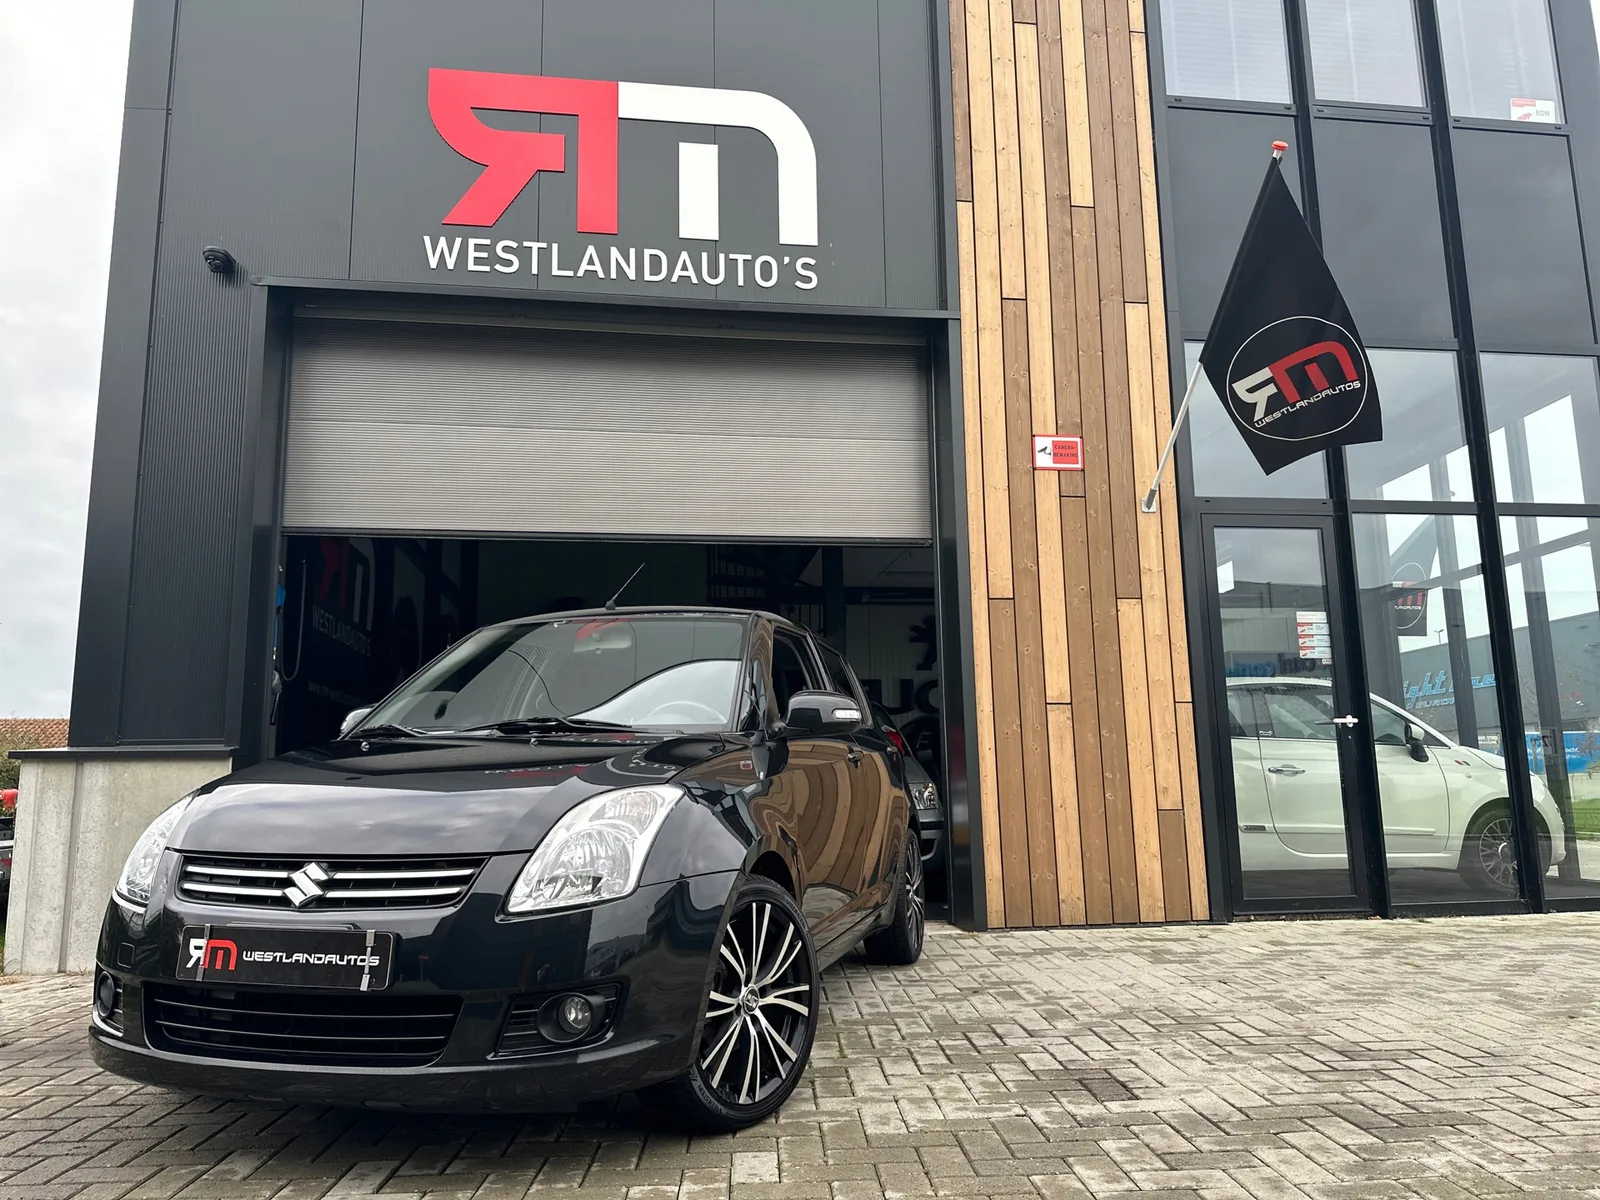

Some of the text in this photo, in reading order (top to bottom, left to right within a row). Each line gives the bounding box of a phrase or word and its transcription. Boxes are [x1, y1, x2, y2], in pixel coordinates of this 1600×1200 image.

[423, 235, 819, 290] WESTLANDAUTO'S
[1254, 380, 1361, 428] WESTLANDAUTOS
[1403, 670, 1447, 709] ight
[243, 950, 380, 967] WESTLANDAUTOS
